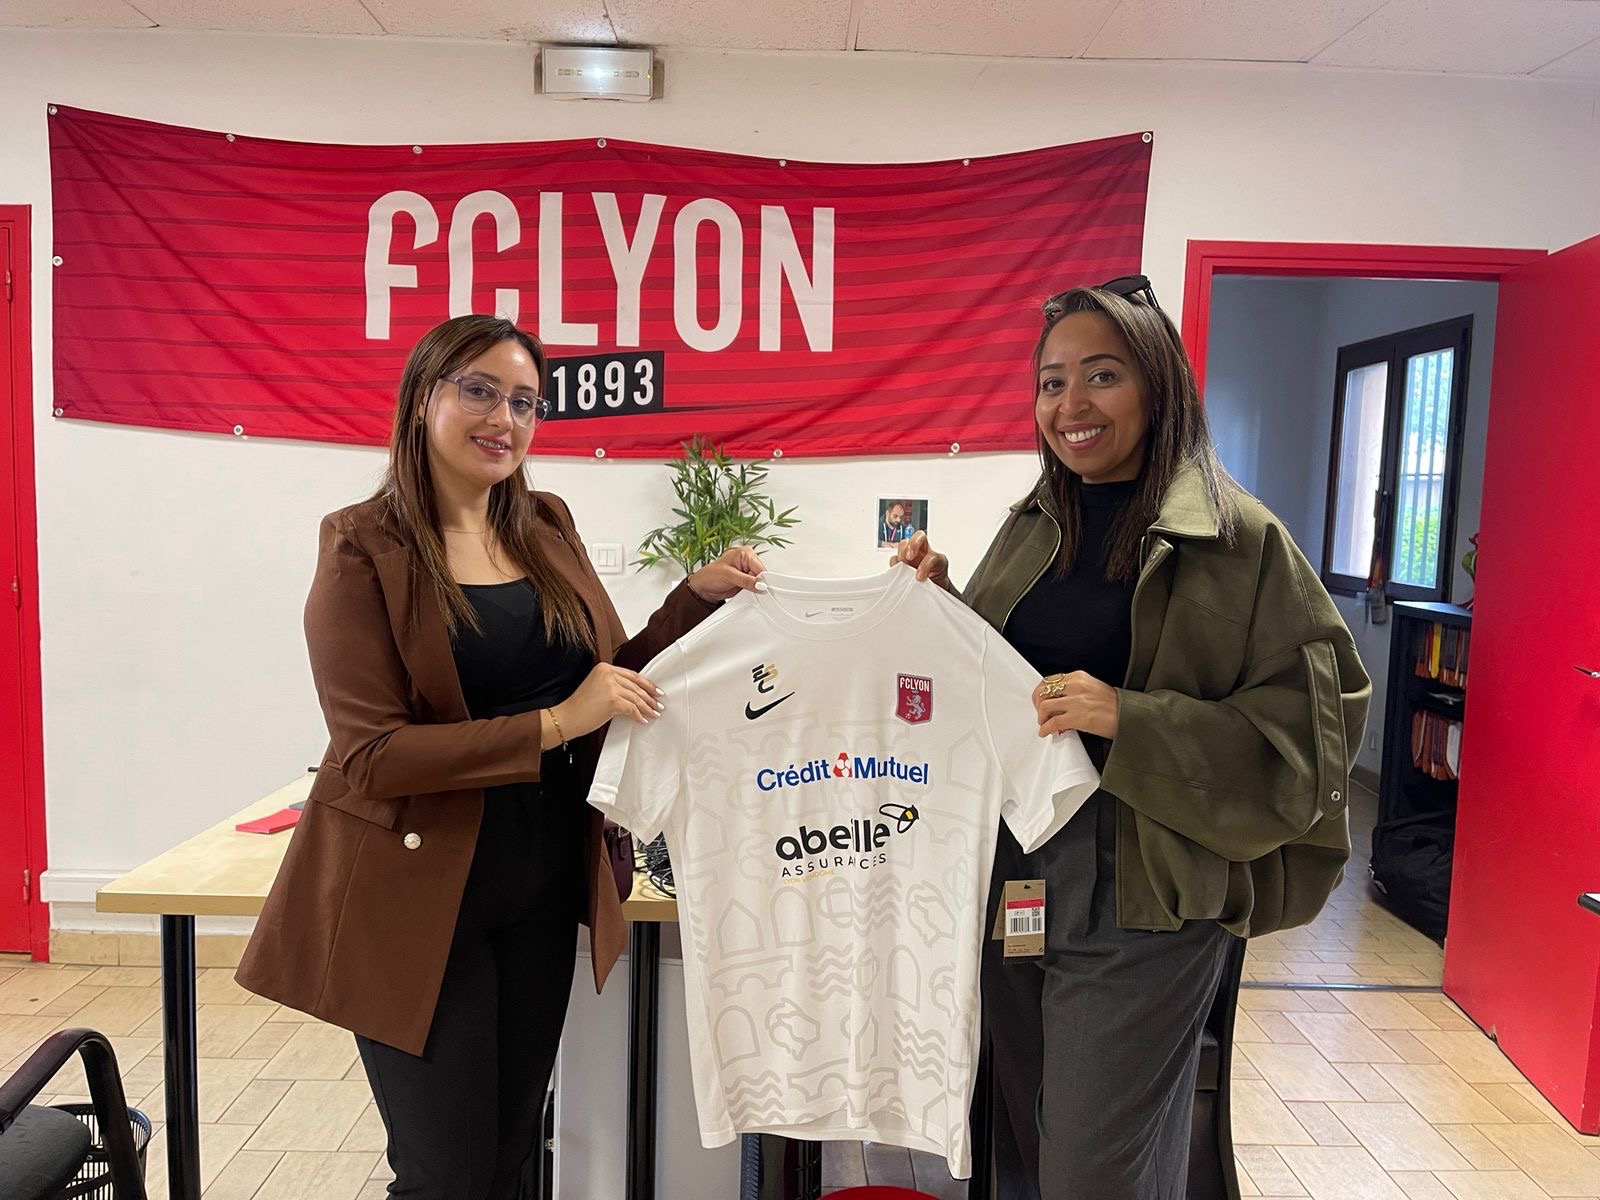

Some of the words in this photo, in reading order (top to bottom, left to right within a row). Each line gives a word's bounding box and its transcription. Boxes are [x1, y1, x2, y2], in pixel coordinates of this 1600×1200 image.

[365, 190, 835, 352] FCLYON
[552, 358, 655, 413] 1893
[900, 677, 930, 692] FCLYON
[757, 759, 832, 791] Crédit
[854, 756, 929, 785] Mutuel
